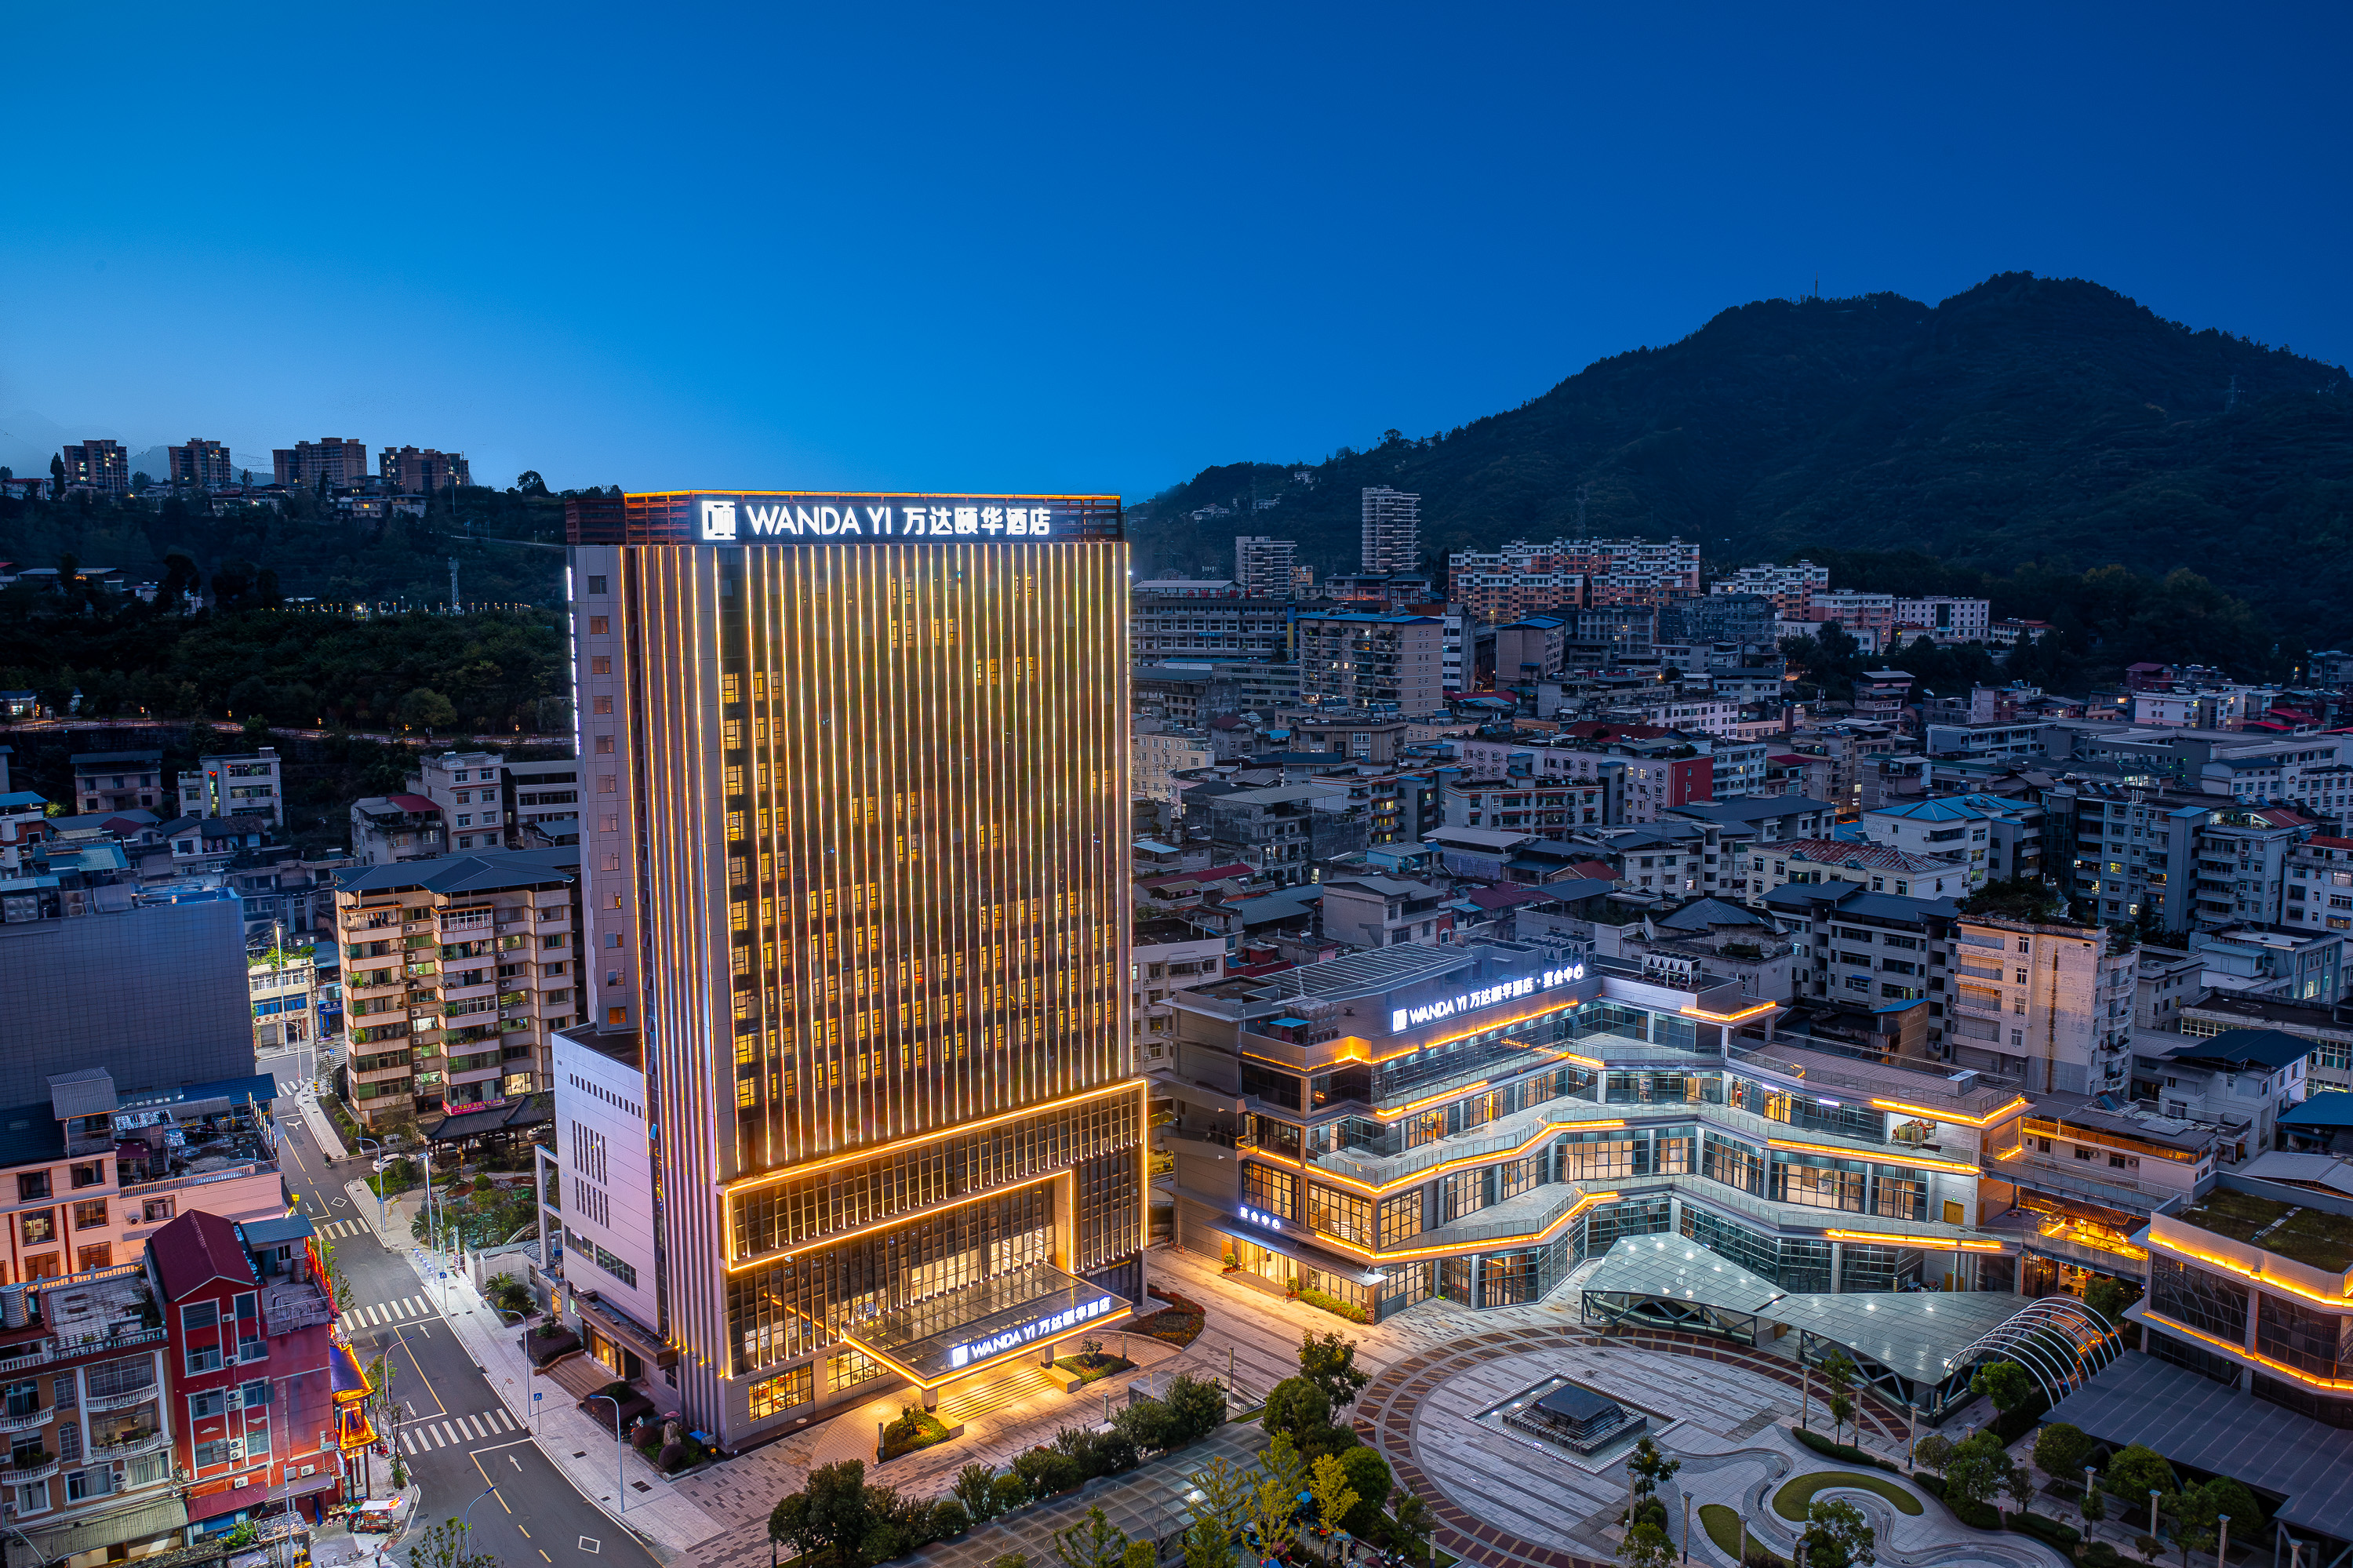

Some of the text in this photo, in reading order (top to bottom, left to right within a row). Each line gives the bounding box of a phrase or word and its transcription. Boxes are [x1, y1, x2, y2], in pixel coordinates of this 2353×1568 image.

[746, 505, 1051, 536] WANDA YI 万达颐华酒店
[1409, 999, 1455, 1024] WANDA
[1456, 995, 1467, 1012] YI
[971, 1330, 1022, 1359] WANDA
[1023, 1324, 1035, 1341] YI
